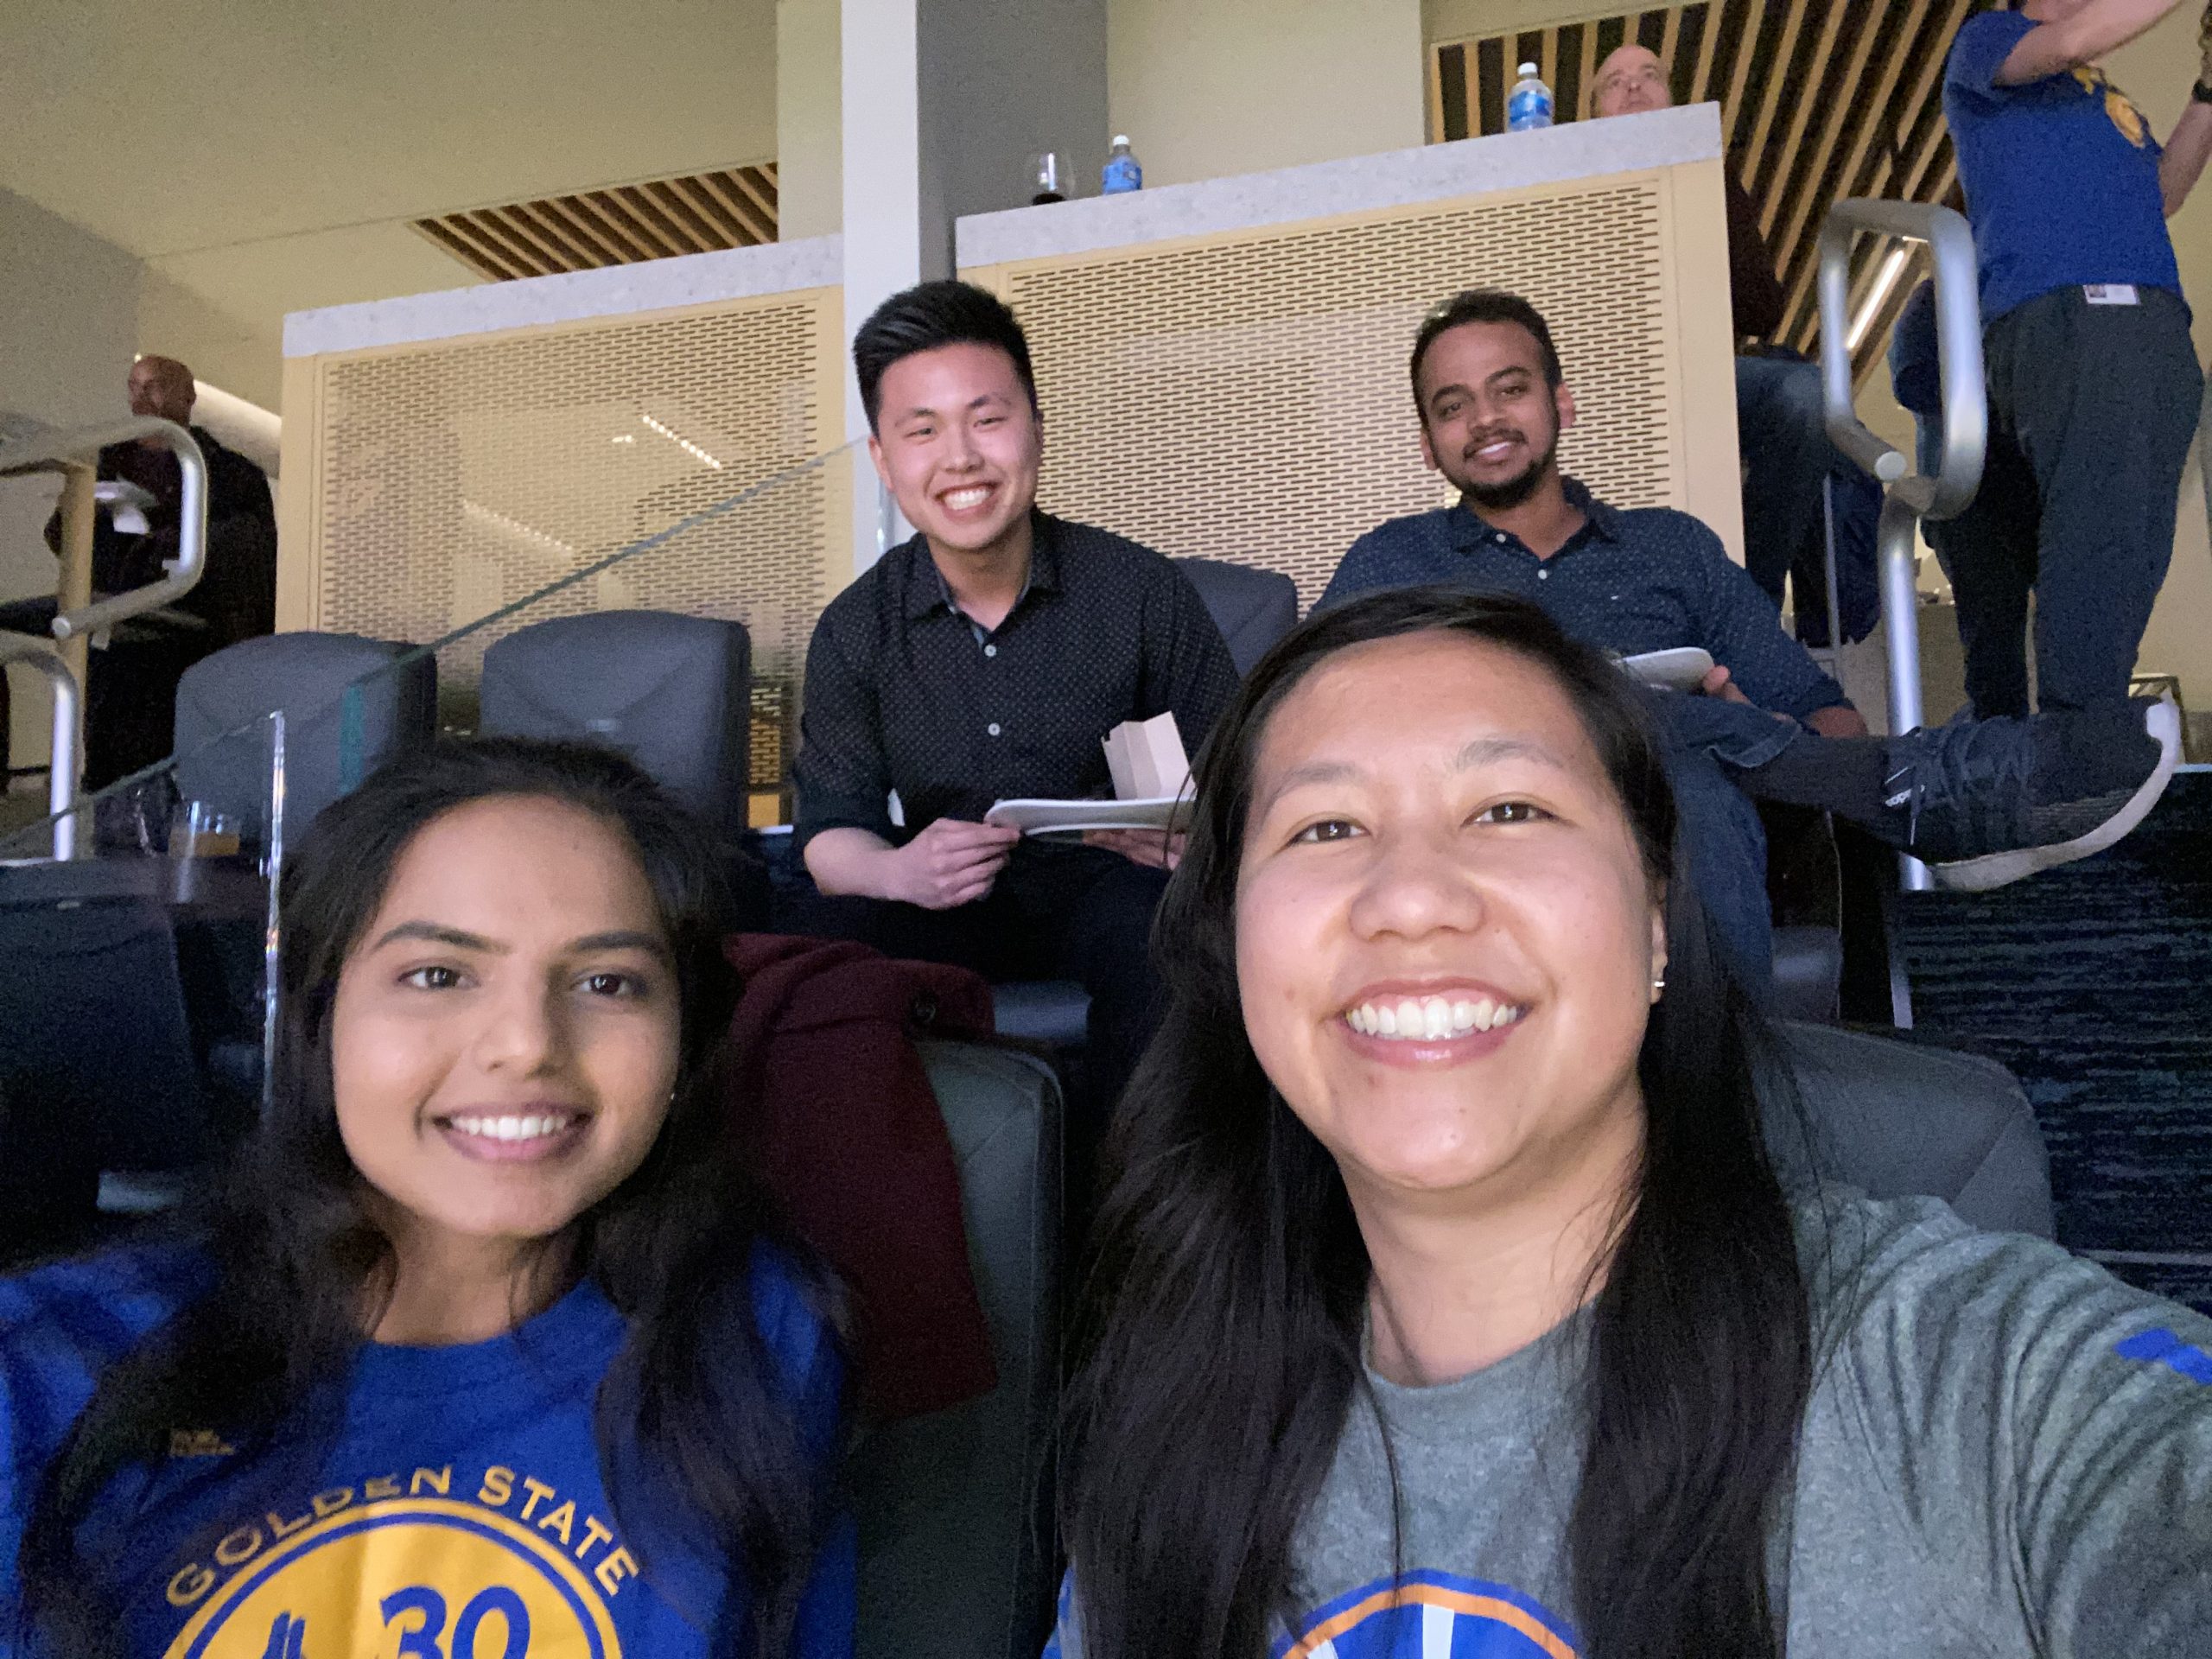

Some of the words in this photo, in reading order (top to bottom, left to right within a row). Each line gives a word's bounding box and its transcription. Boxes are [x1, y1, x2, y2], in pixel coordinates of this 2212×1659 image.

[166, 1463, 453, 1606] GOLDEN
[478, 1465, 639, 1596] STATE
[379, 1585, 531, 1659] 30
